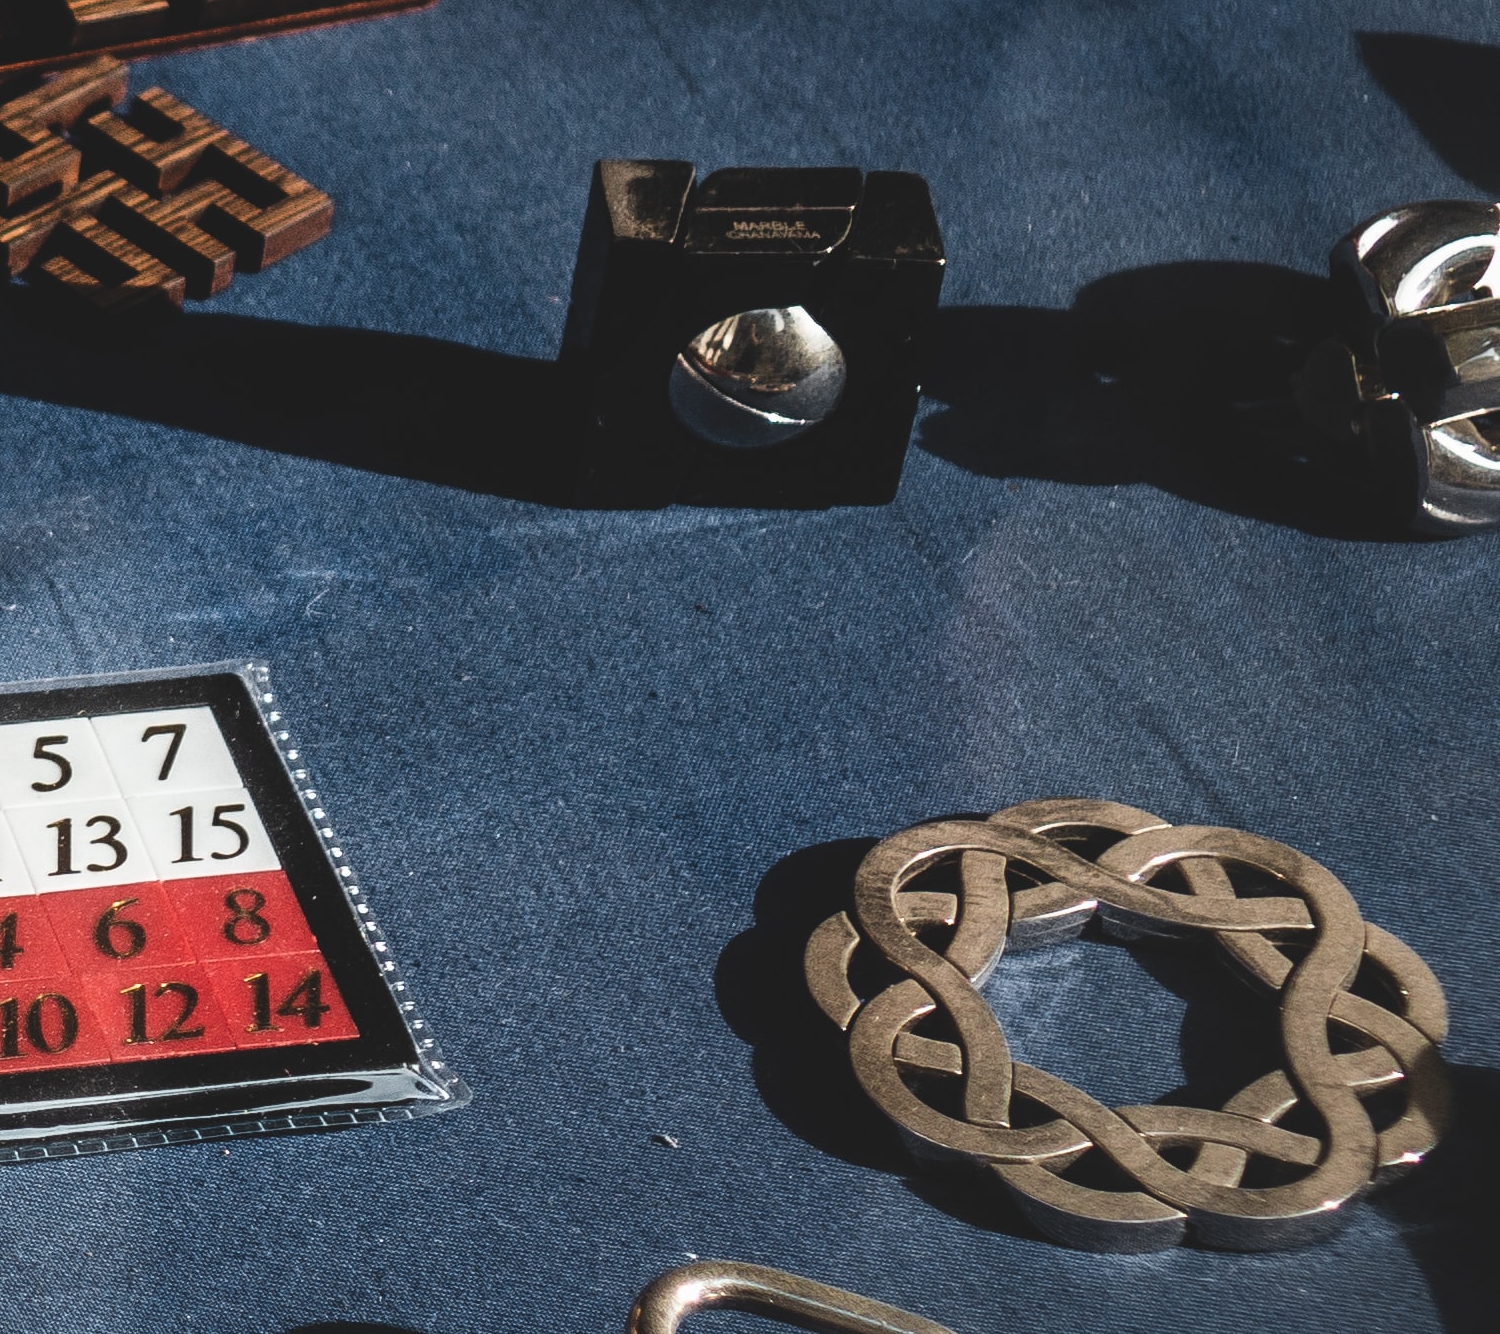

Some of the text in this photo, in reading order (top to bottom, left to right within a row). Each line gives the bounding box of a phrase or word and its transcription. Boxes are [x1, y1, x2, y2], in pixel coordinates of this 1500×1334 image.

[732, 220, 806, 231] MARBLE
[32, 736, 71, 792] 5
[142, 724, 186, 780] 7
[48, 816, 127, 875] 13
[171, 804, 248, 862] 15
[93, 895, 148, 960] 6
[219, 887, 274, 947] 8
[120, 981, 208, 1046] 12
[242, 969, 332, 1034] 14
